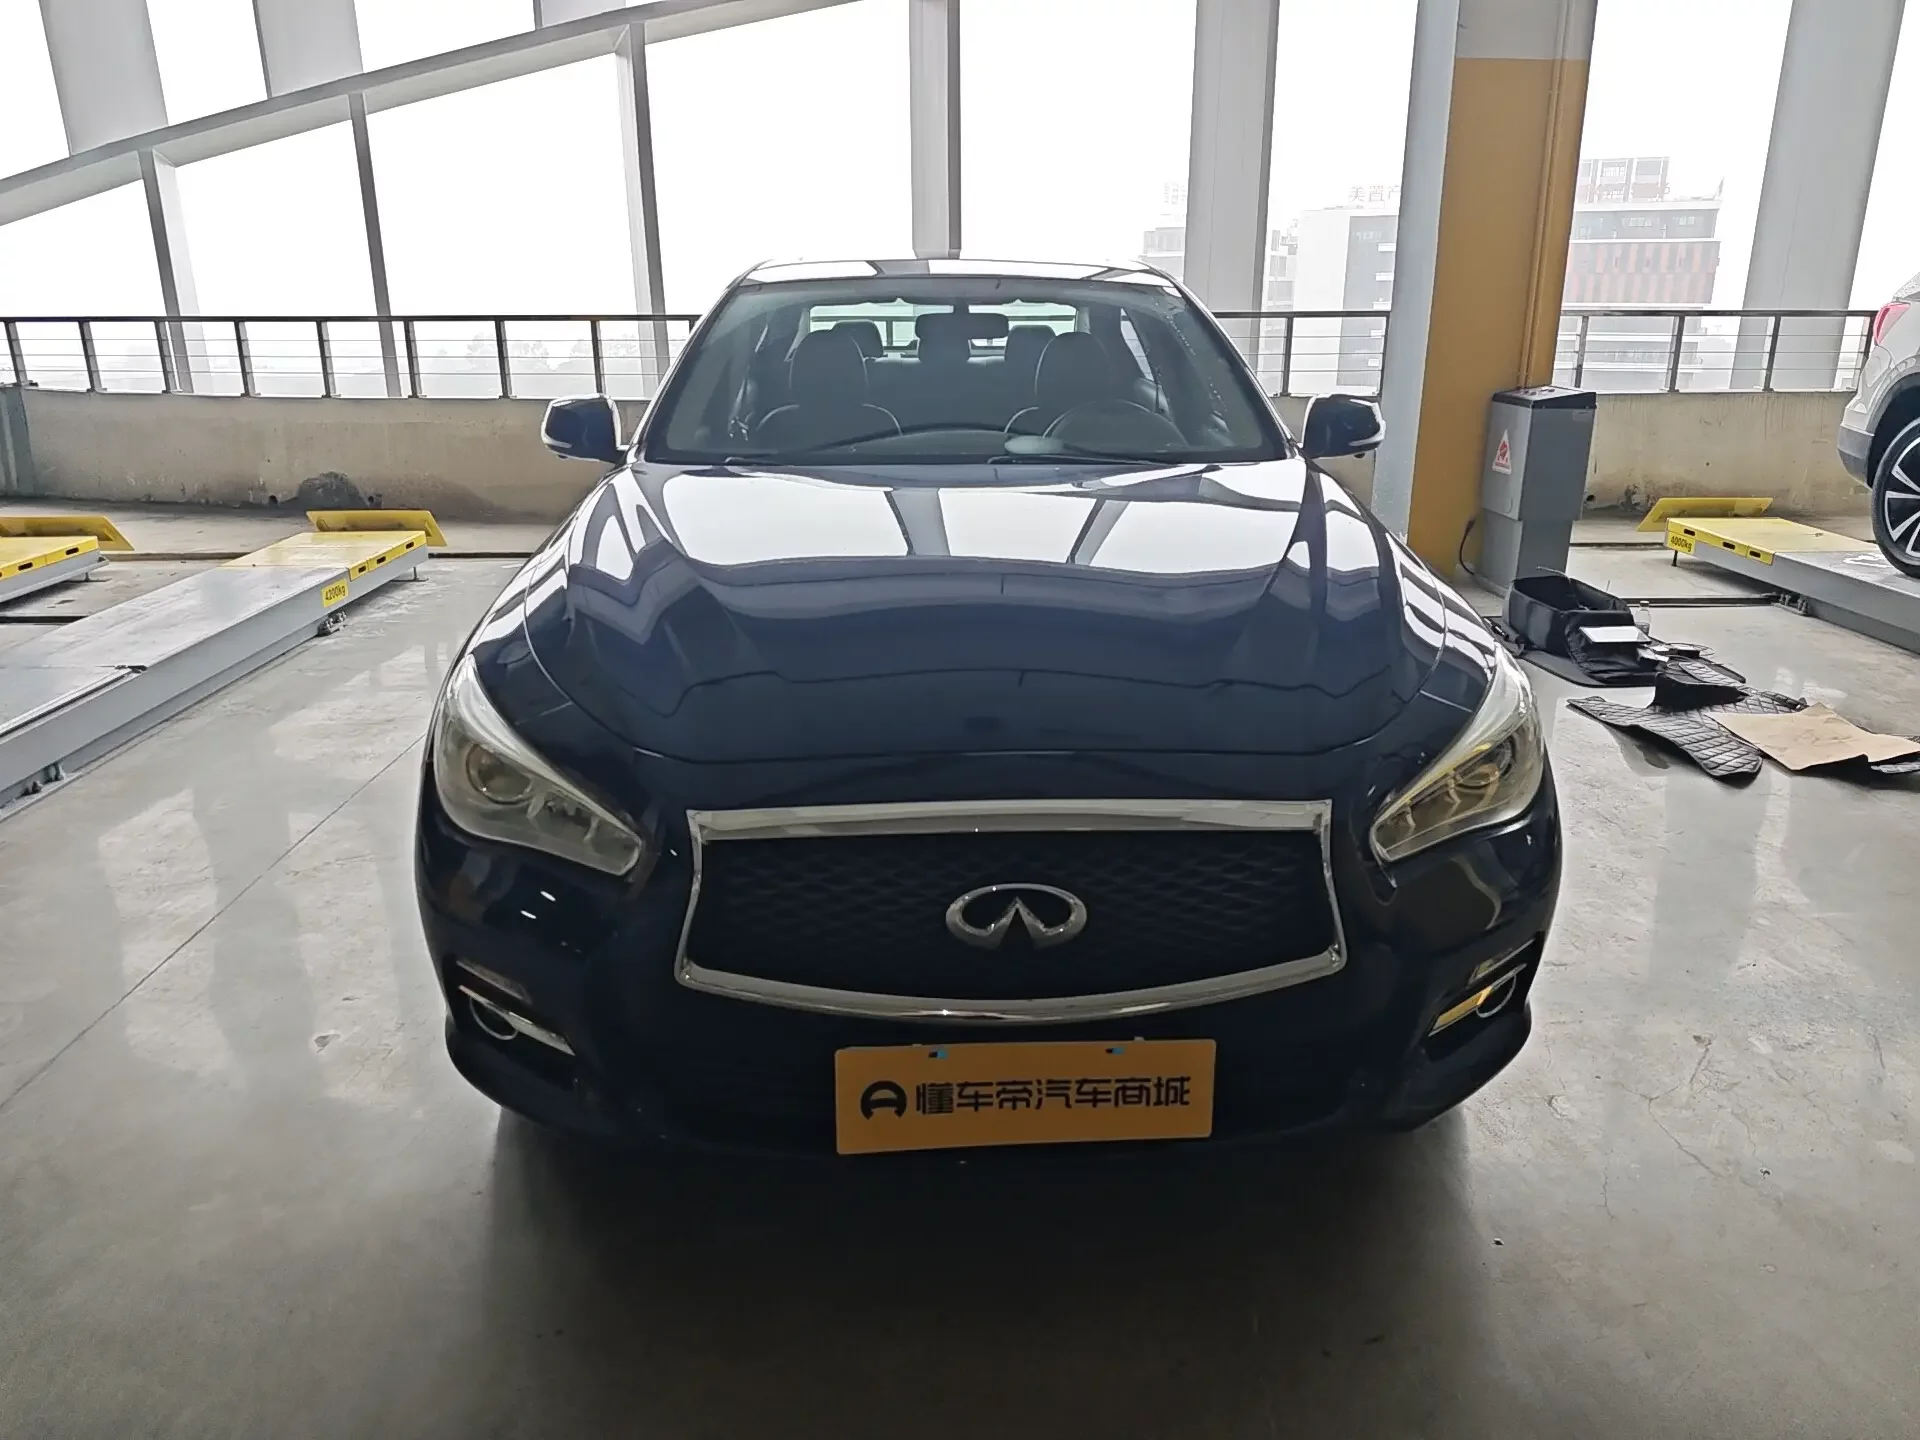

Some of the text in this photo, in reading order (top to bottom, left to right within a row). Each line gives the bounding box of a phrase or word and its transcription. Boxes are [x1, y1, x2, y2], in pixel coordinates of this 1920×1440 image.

[916, 1076, 1191, 1115] 懂车帝汽车商城
